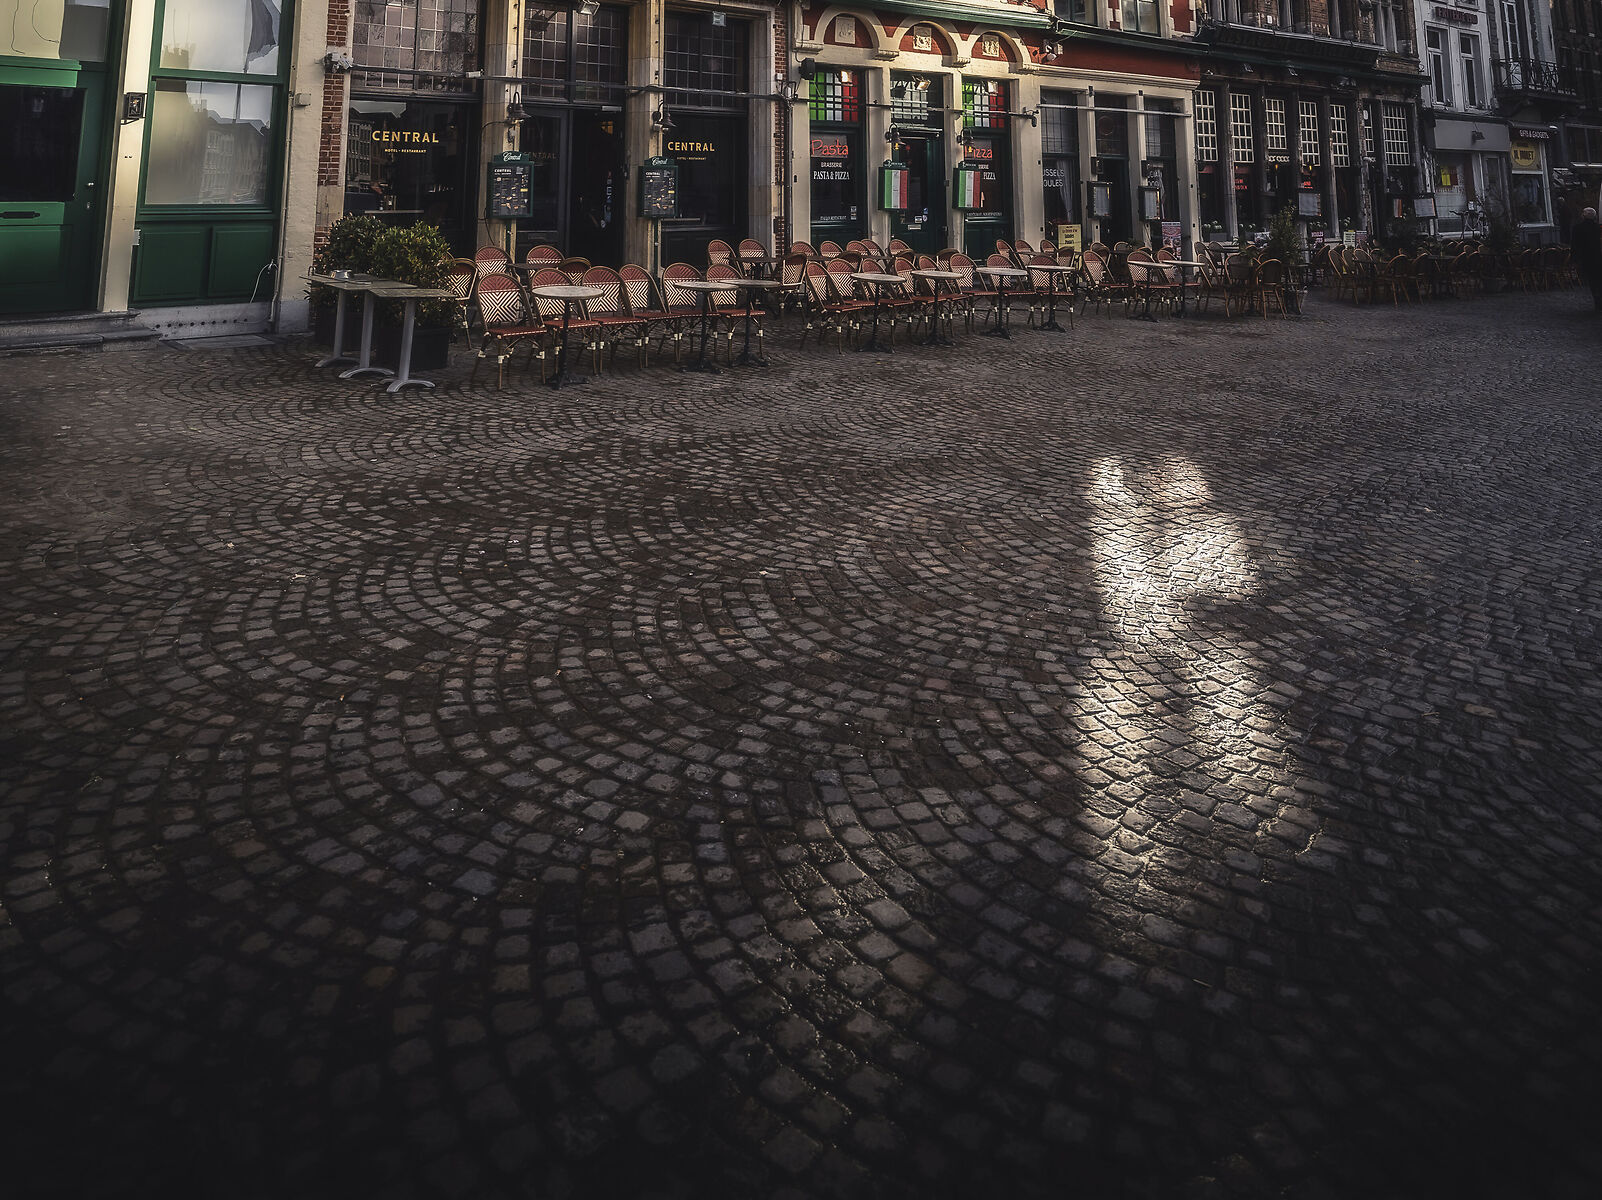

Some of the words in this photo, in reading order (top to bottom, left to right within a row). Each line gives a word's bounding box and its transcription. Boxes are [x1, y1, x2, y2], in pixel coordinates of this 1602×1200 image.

[372, 130, 439, 143] CENTRAL
[667, 141, 715, 152] CENTRAL
[811, 139, 849, 156] Pasta
[813, 170, 830, 180] PASTA
[834, 171, 850, 180] PIZZA
